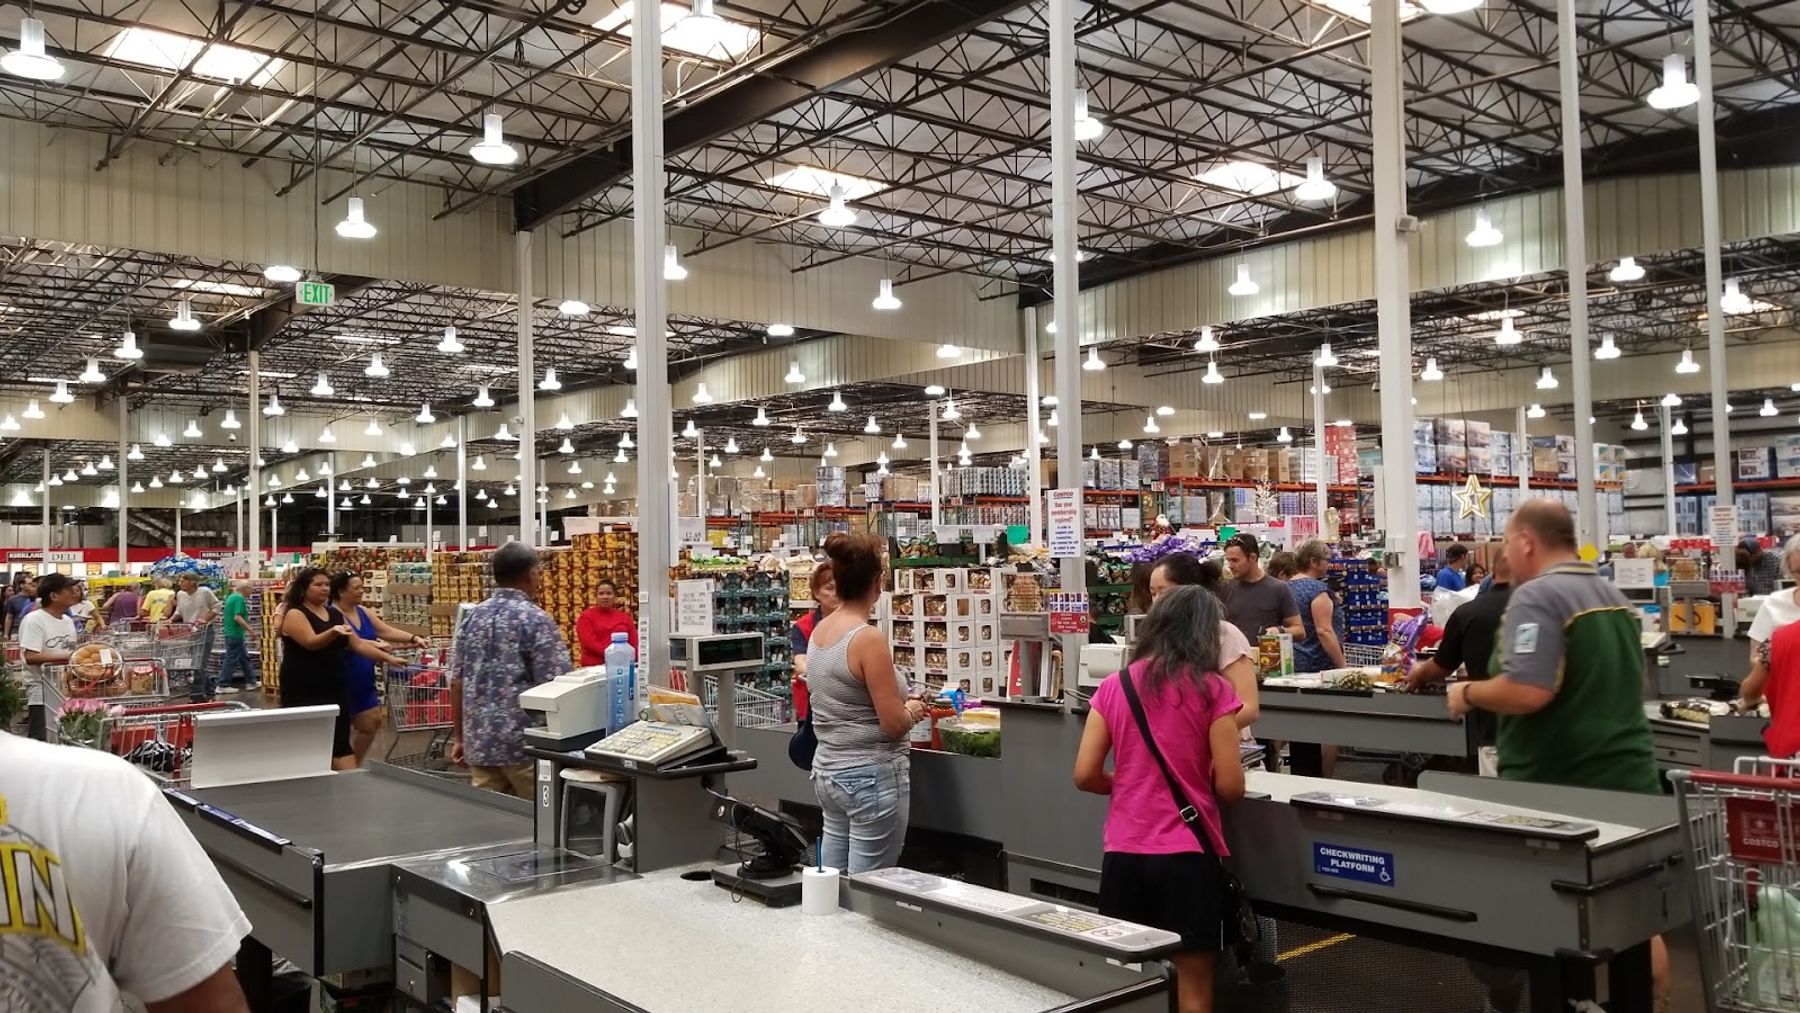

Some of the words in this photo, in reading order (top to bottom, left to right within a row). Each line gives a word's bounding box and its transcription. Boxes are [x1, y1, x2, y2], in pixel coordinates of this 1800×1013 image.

[304, 284, 329, 304] EXIT
[1742, 837, 1779, 848] COSTCO
[1320, 847, 1385, 865] CHECKWRITING
[1330, 858, 1375, 873] PLATFORM
